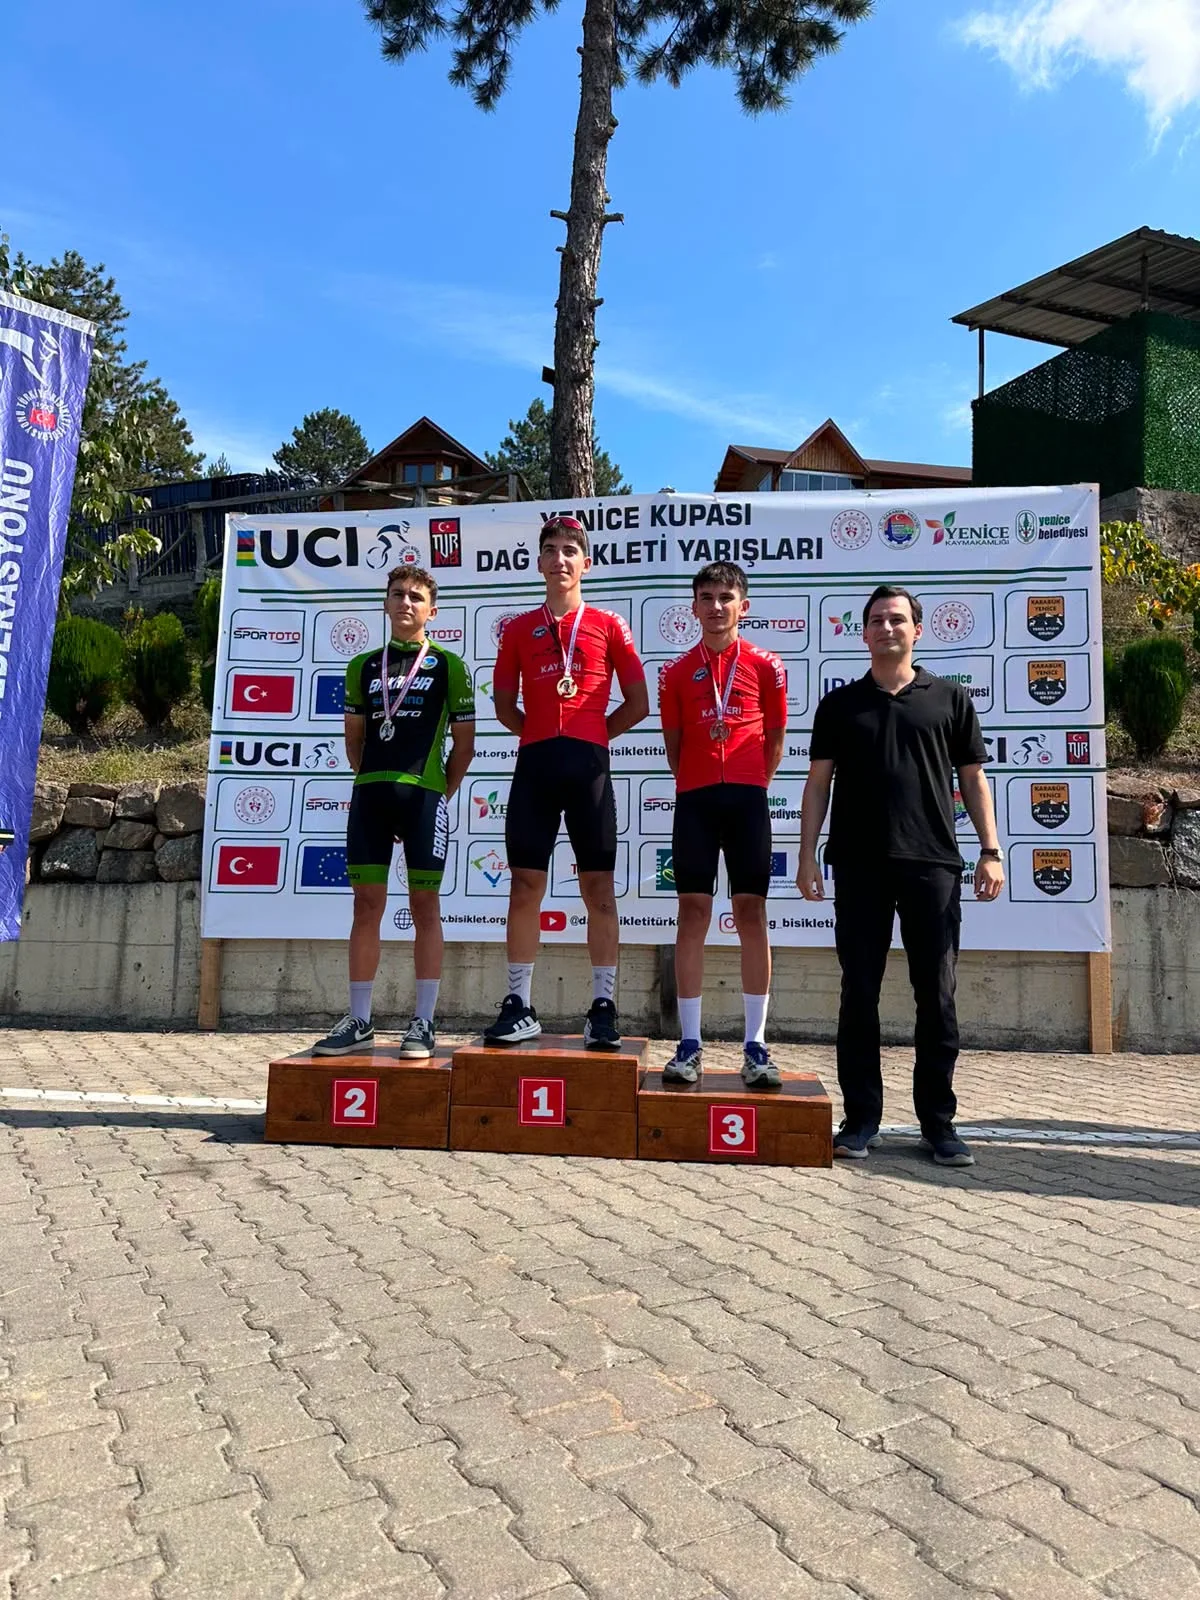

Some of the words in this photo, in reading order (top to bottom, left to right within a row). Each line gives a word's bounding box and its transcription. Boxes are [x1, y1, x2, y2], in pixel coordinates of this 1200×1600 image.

[650, 502, 751, 527] KUPASI
[1038, 514, 1071, 527] yenice
[945, 523, 1010, 540] YENİCE
[1038, 526, 1088, 540] belediyesi
[259, 526, 359, 568] UCI
[476, 542, 530, 572] DAĞ
[592, 533, 667, 566] KLETİ
[677, 537, 824, 568] YARIŞLARI
[235, 741, 301, 767] UCI
[343, 1088, 367, 1118] 2
[532, 1087, 554, 1117] 1
[721, 1114, 746, 1146] 3
